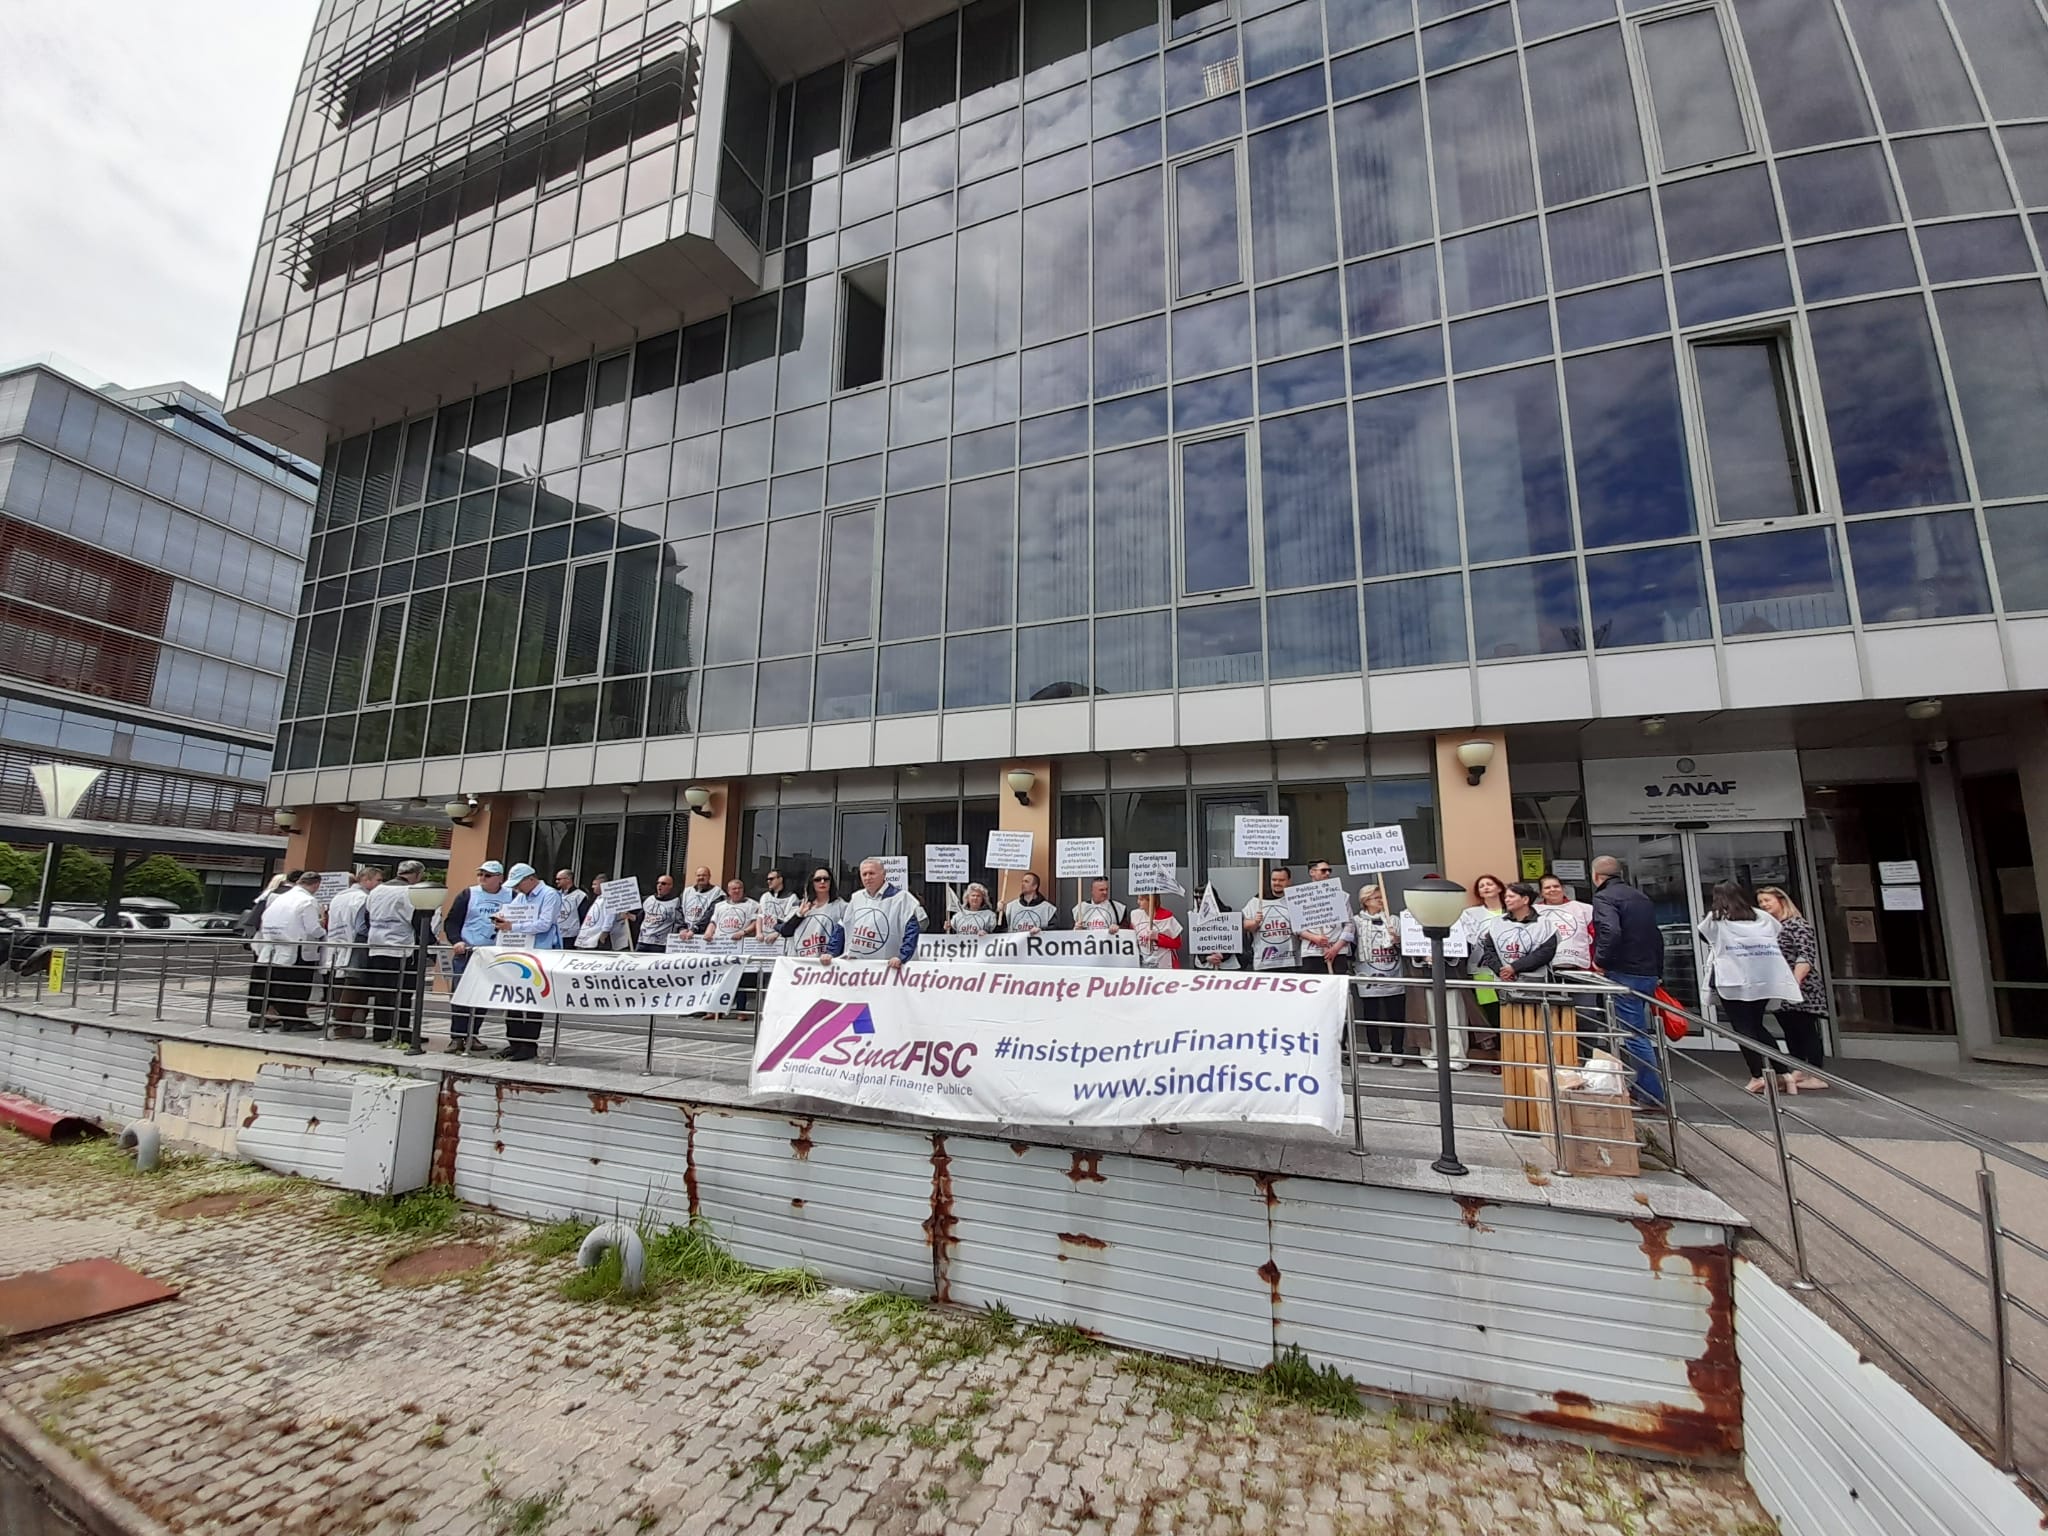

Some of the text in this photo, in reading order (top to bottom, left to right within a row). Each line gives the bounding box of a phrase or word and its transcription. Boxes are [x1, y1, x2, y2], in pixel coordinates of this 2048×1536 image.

[1666, 781, 1736, 797] ANAF
[1385, 830, 1398, 838] de
[1347, 844, 1404, 857] finanțe, nu
[1350, 858, 1406, 872] simulacru!
[1214, 915, 1229, 923] cții
[1264, 920, 1287, 930] alfa
[1192, 924, 1230, 933] specifice,
[802, 932, 826, 947] alfa
[919, 934, 1135, 961] nțiștii din România
[1196, 944, 1235, 952] specifice!
[572, 970, 724, 991] a Sindicatelor din
[791, 965, 891, 988] Sindicatul
[1087, 974, 1321, 998] Publice-SindFISC
[489, 985, 537, 1005] FNSA
[820, 1035, 978, 1079] SindFISC
[781, 1061, 838, 1078] Sindicatul
[937, 1079, 973, 1096] Publice
[1073, 1064, 1320, 1101] www.sindfisc.ro
